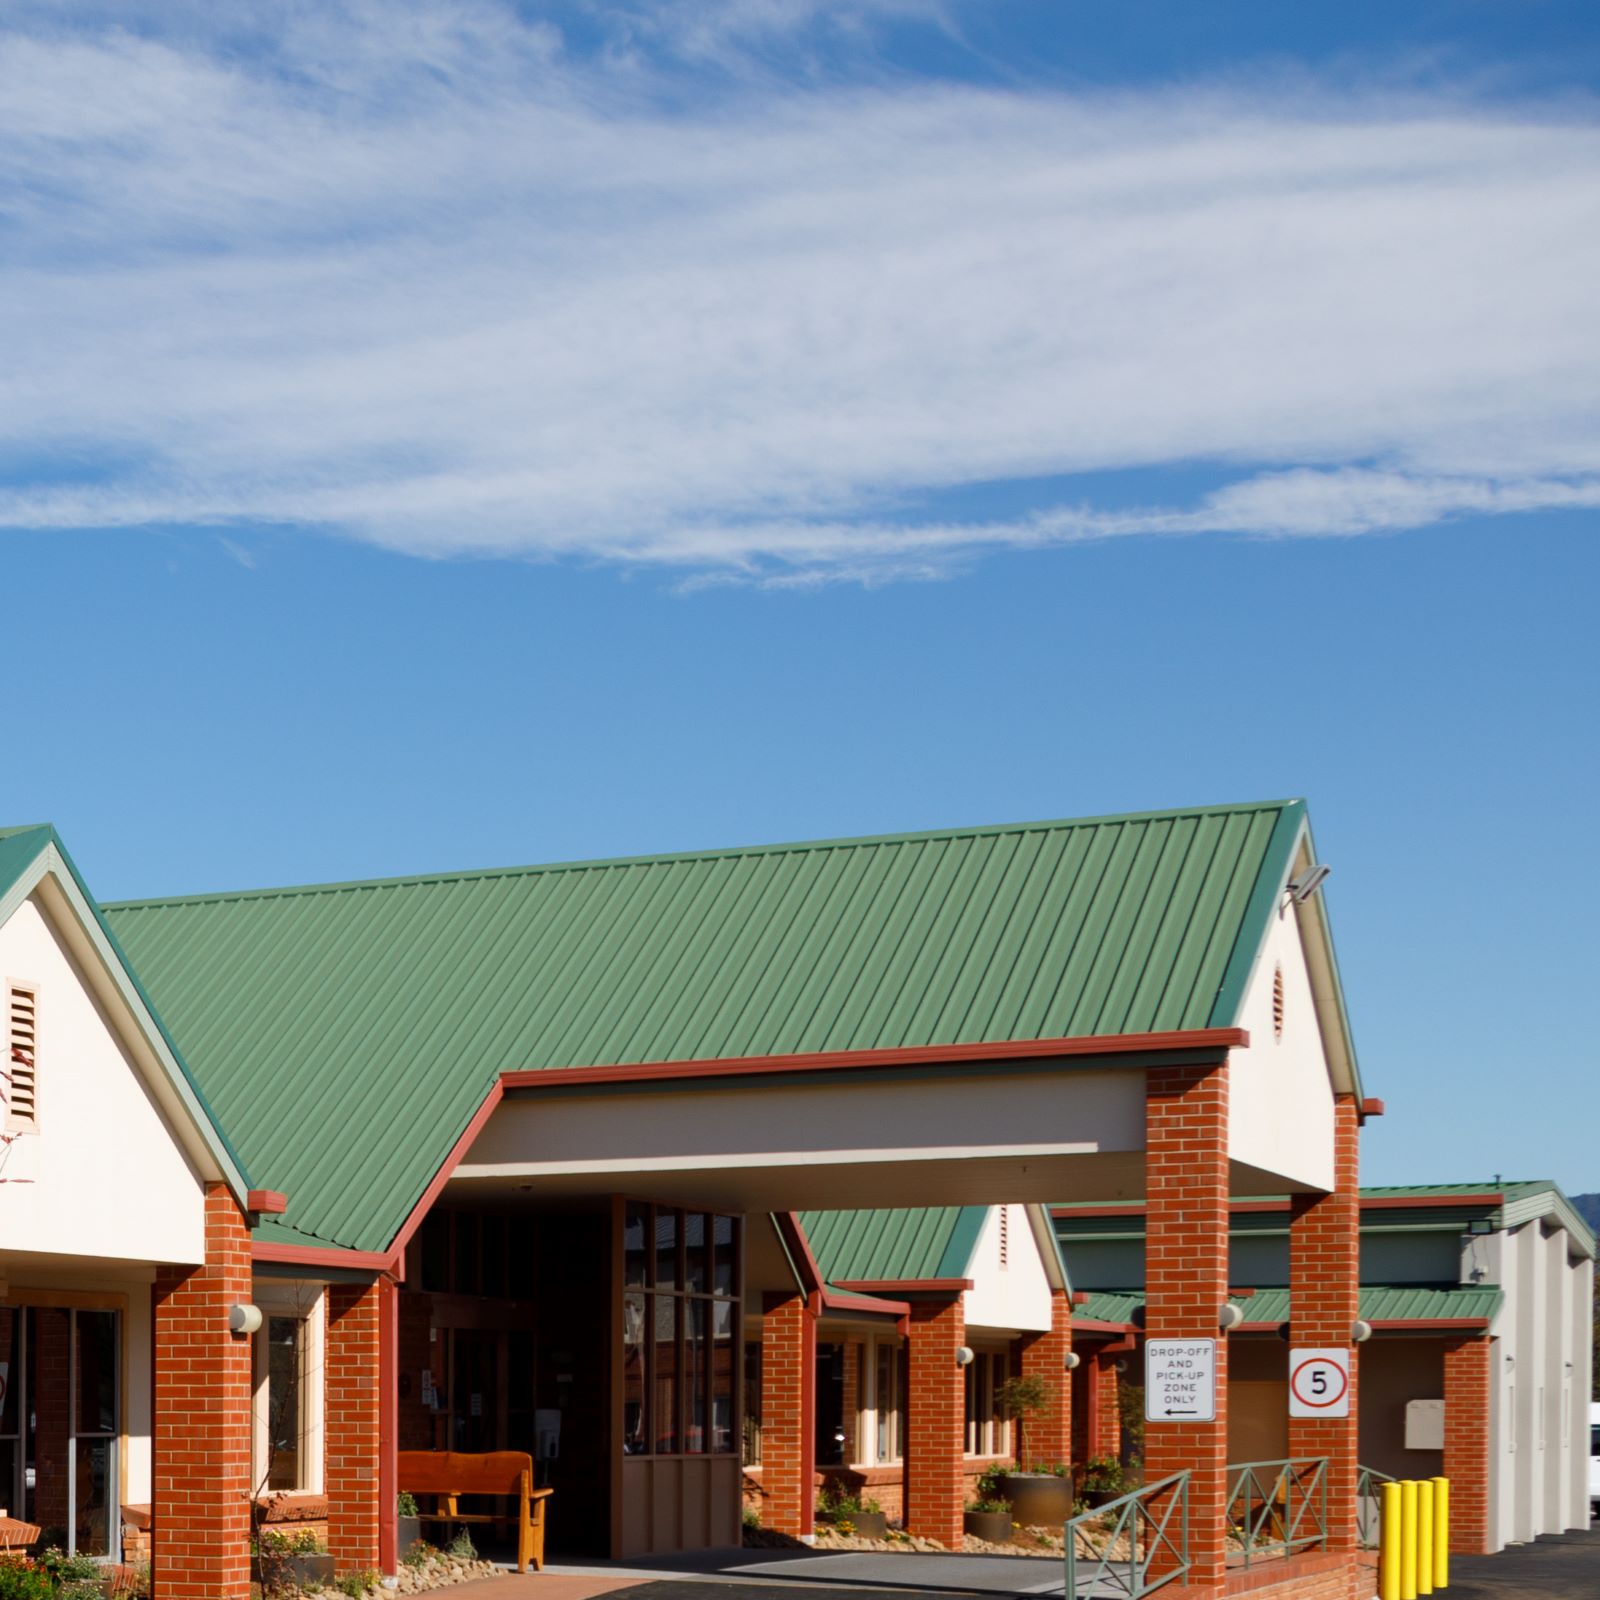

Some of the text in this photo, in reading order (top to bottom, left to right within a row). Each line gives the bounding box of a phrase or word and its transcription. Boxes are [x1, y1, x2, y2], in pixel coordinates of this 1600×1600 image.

[1150, 1347, 1211, 1357] DROP-OFF
[1168, 1360, 1193, 1368] AND
[1156, 1371, 1205, 1380] PICK-UP
[1312, 1371, 1327, 1394] 5
[1164, 1383, 1197, 1392] ZONE
[1164, 1395, 1196, 1404] ONLY
